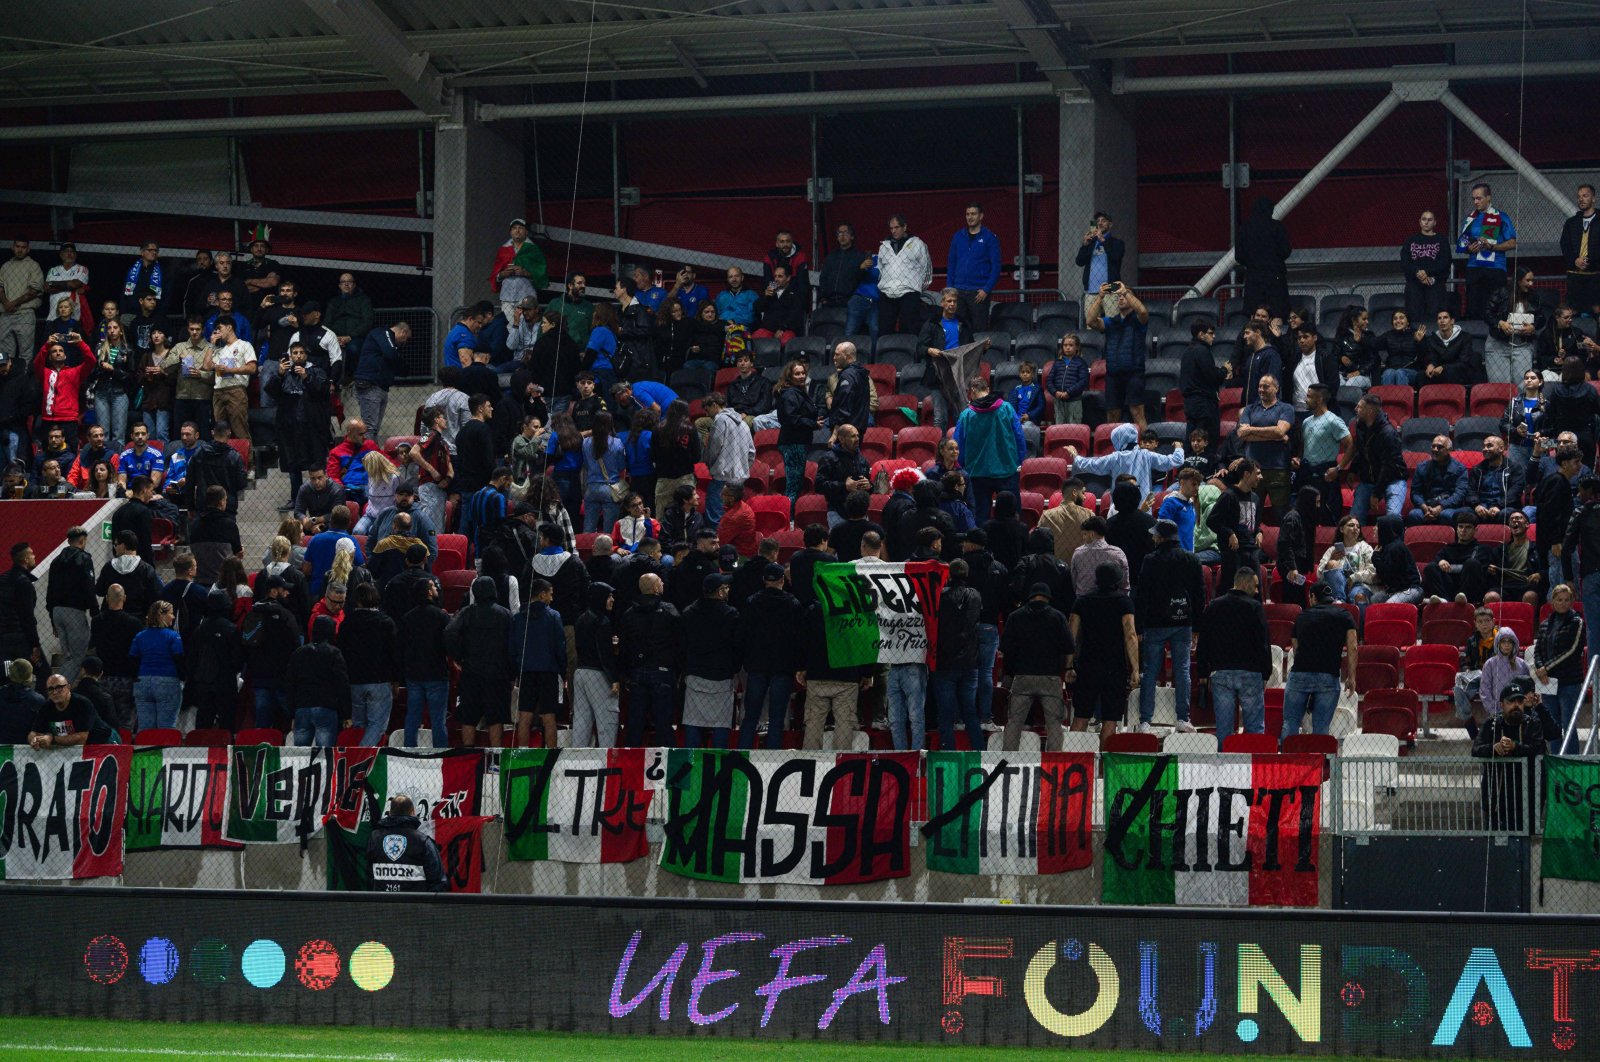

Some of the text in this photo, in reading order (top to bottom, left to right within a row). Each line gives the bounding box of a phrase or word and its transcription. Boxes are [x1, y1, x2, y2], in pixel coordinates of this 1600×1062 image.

[840, 616, 864, 632] per
[872, 637, 892, 650] con
[934, 763, 1089, 859] LATINA
[1107, 785, 1319, 873] CHIETI
[375, 866, 414, 878] אבטחה
[608, 930, 908, 1030] UEFA
